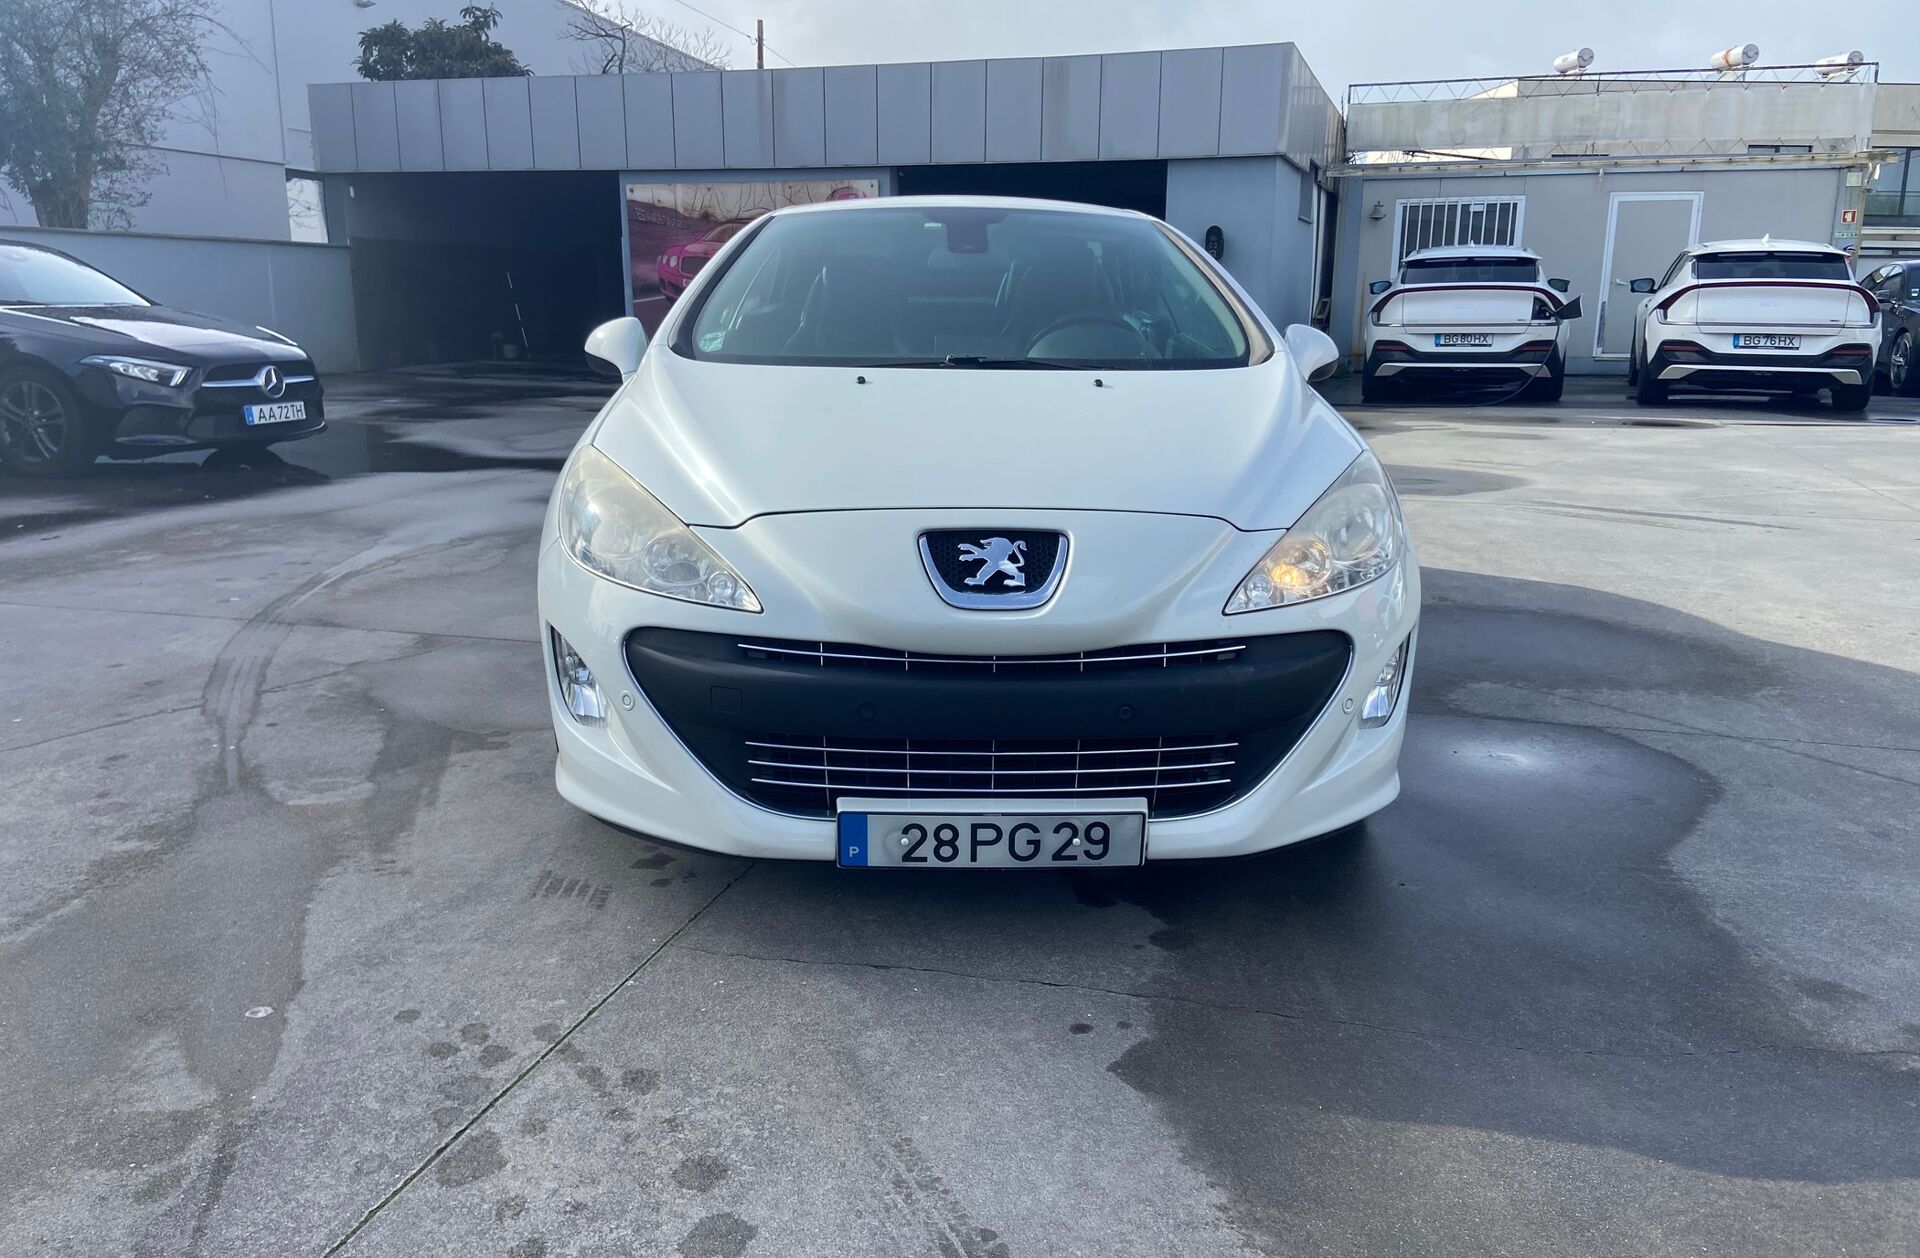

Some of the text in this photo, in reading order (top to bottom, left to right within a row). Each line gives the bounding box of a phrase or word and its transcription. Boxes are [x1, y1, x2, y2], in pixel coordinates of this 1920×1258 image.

[1743, 336, 1796, 346] BG76HX
[258, 404, 304, 422] AA72TH
[849, 821, 1111, 863] P 28PG29
